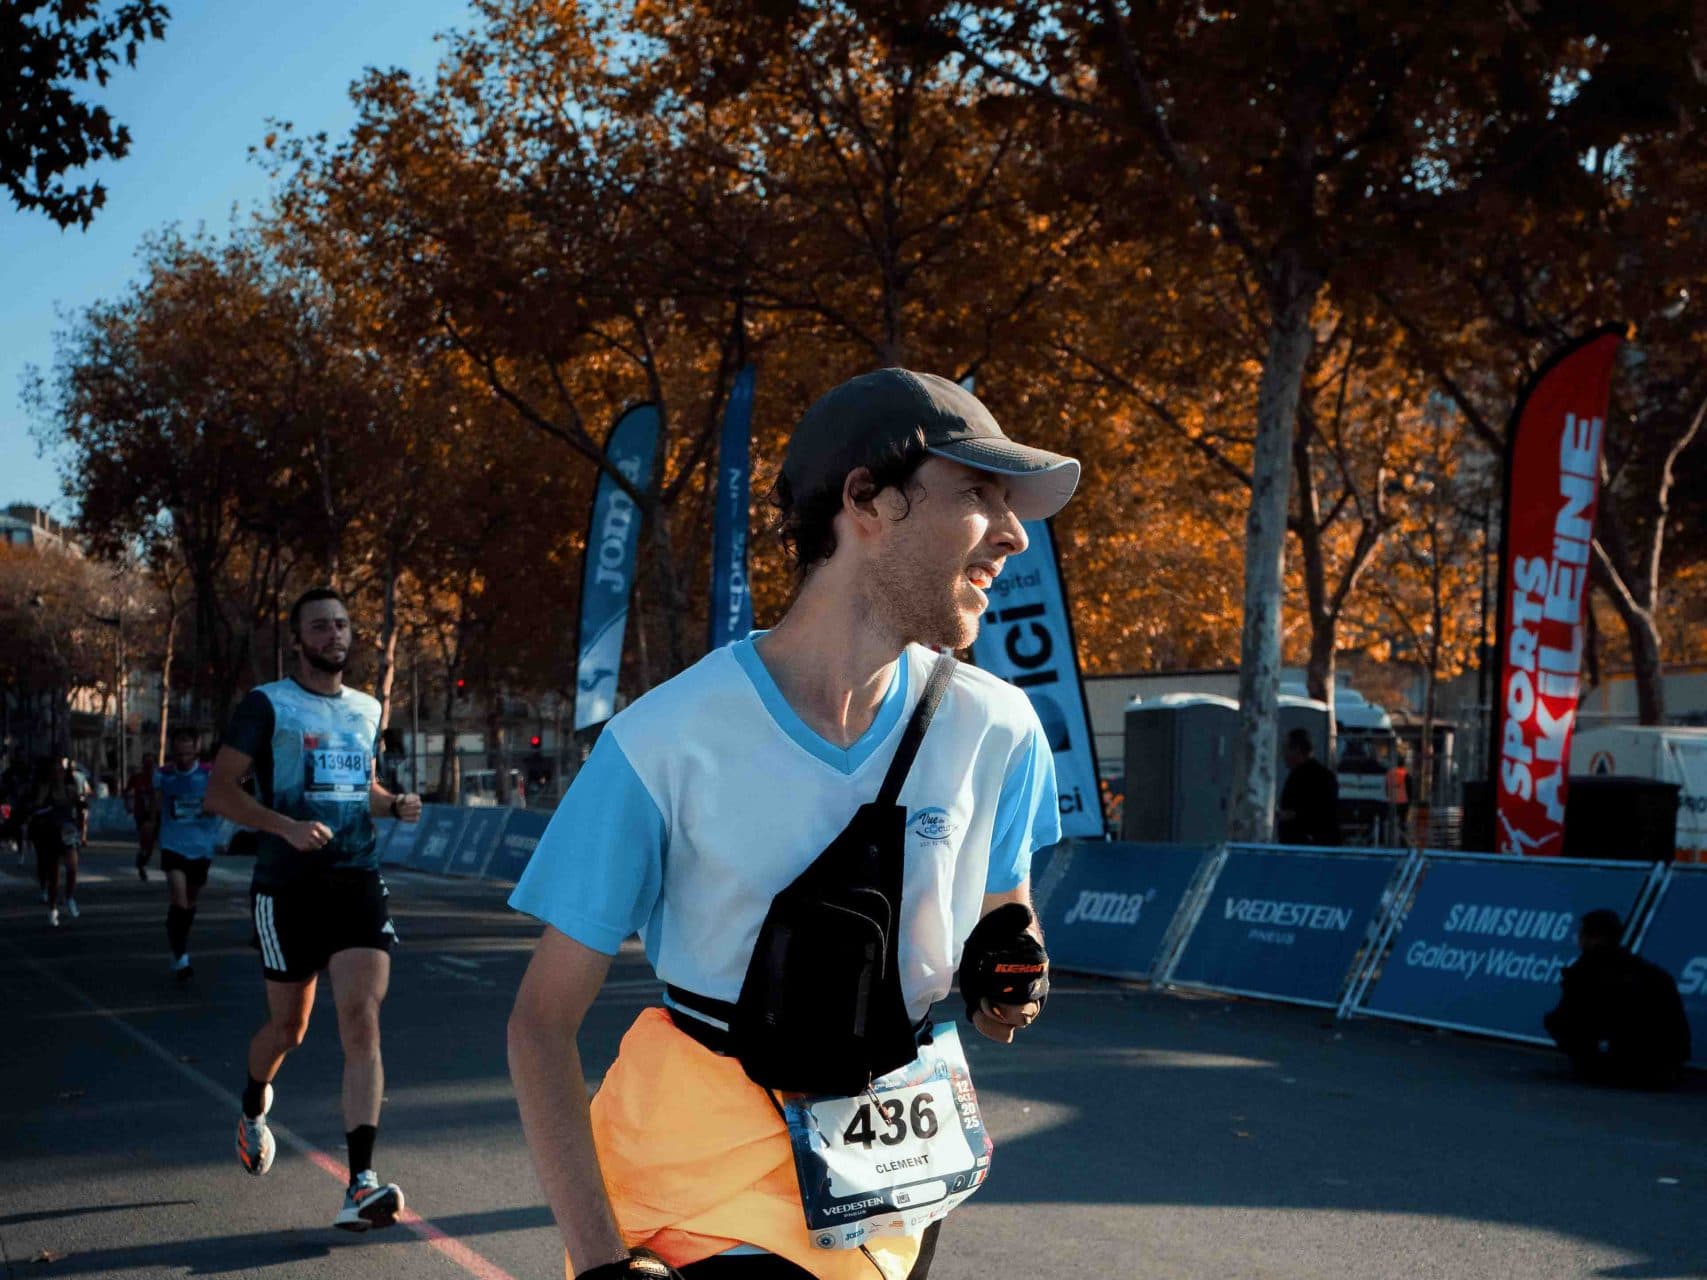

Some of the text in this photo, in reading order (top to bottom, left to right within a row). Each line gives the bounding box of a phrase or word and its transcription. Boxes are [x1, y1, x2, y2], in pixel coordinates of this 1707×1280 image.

[986, 568, 1041, 597] igital
[1502, 556, 1549, 799] SPORTS
[318, 754, 361, 771] 13948
[1058, 786, 1083, 814] ci
[1224, 896, 1353, 931] VREDESTEIN
[1443, 903, 1574, 942] SAMSUNG
[1406, 940, 1578, 984] Galaxy Watch
[843, 1092, 938, 1150] 436
[961, 1102, 976, 1115] 20
[964, 1115, 979, 1129] 25
[875, 1154, 929, 1174] CLEMENT
[822, 1196, 884, 1216] VREDESTEIN
